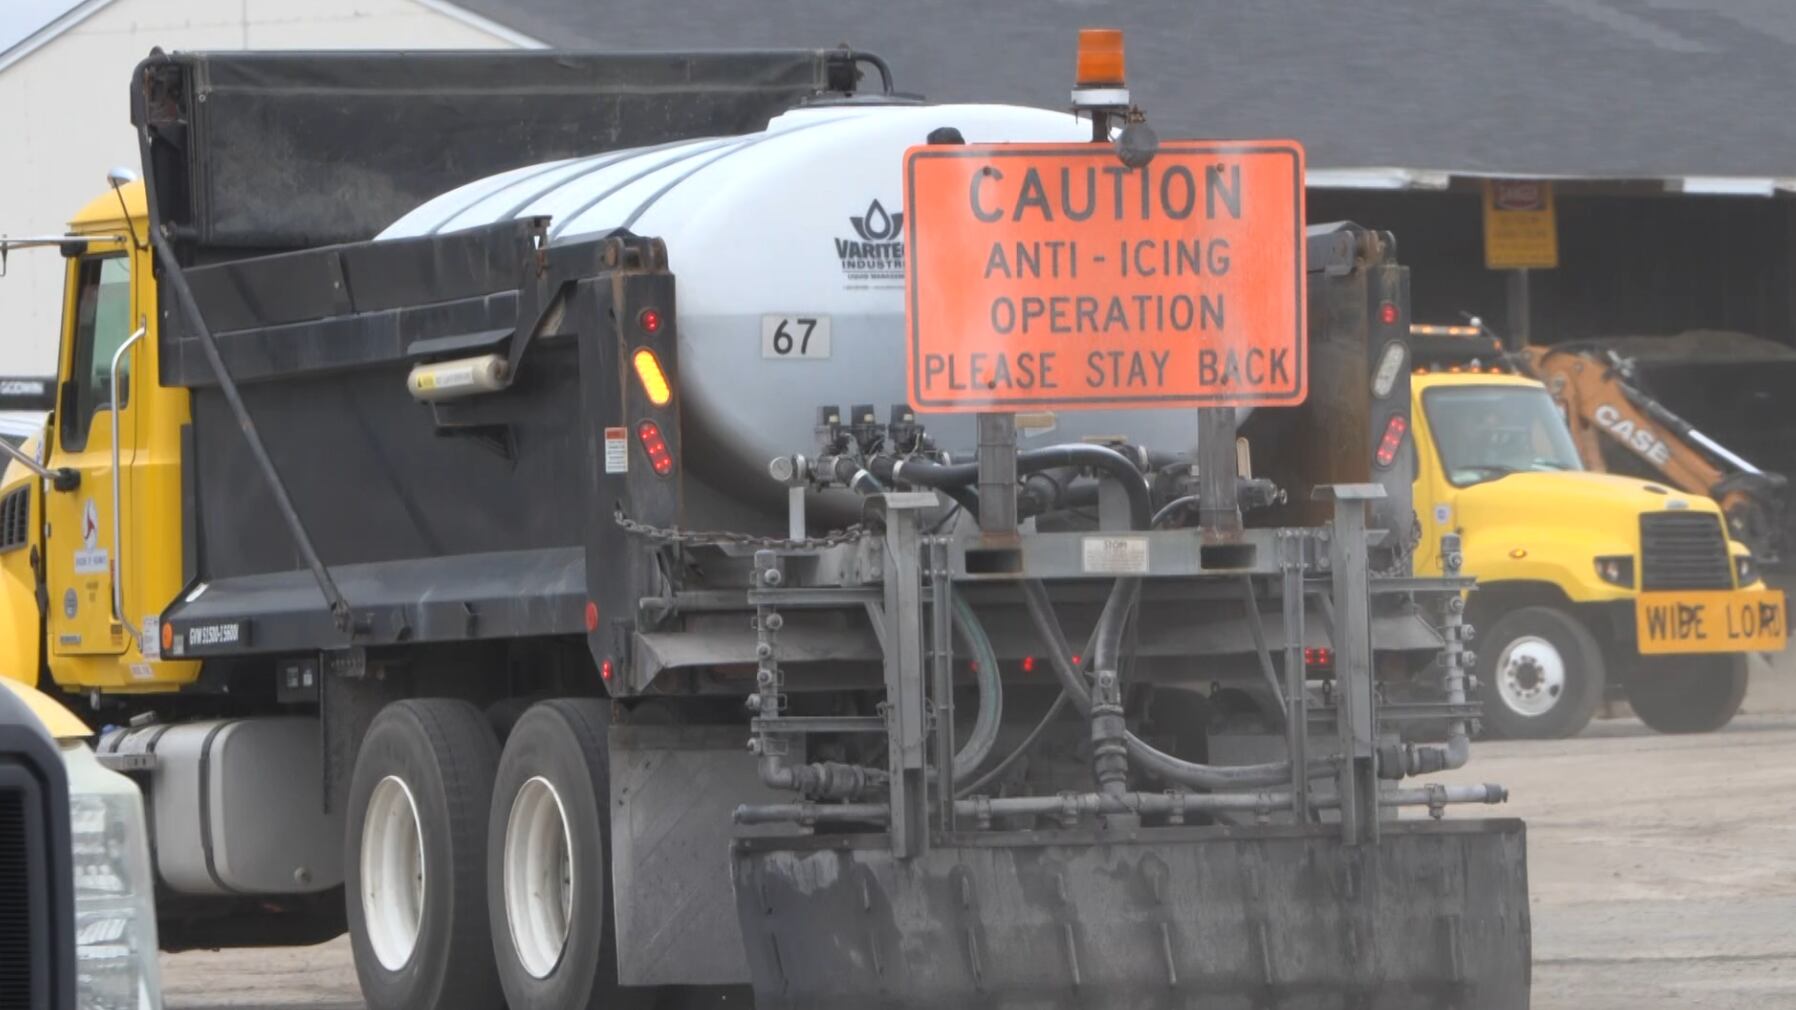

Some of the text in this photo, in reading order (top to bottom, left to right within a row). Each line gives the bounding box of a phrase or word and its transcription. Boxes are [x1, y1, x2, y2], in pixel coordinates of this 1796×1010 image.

[969, 164, 1242, 223] CAUTION
[842, 260, 905, 269] INDUSTR
[984, 241, 1077, 279] ANTI
[1120, 239, 1231, 277] ICING
[990, 294, 1225, 334] OPERATION
[773, 318, 818, 355] 67
[925, 348, 1290, 391] PLEASE STAY BACK
[1595, 404, 1670, 464] CASE
